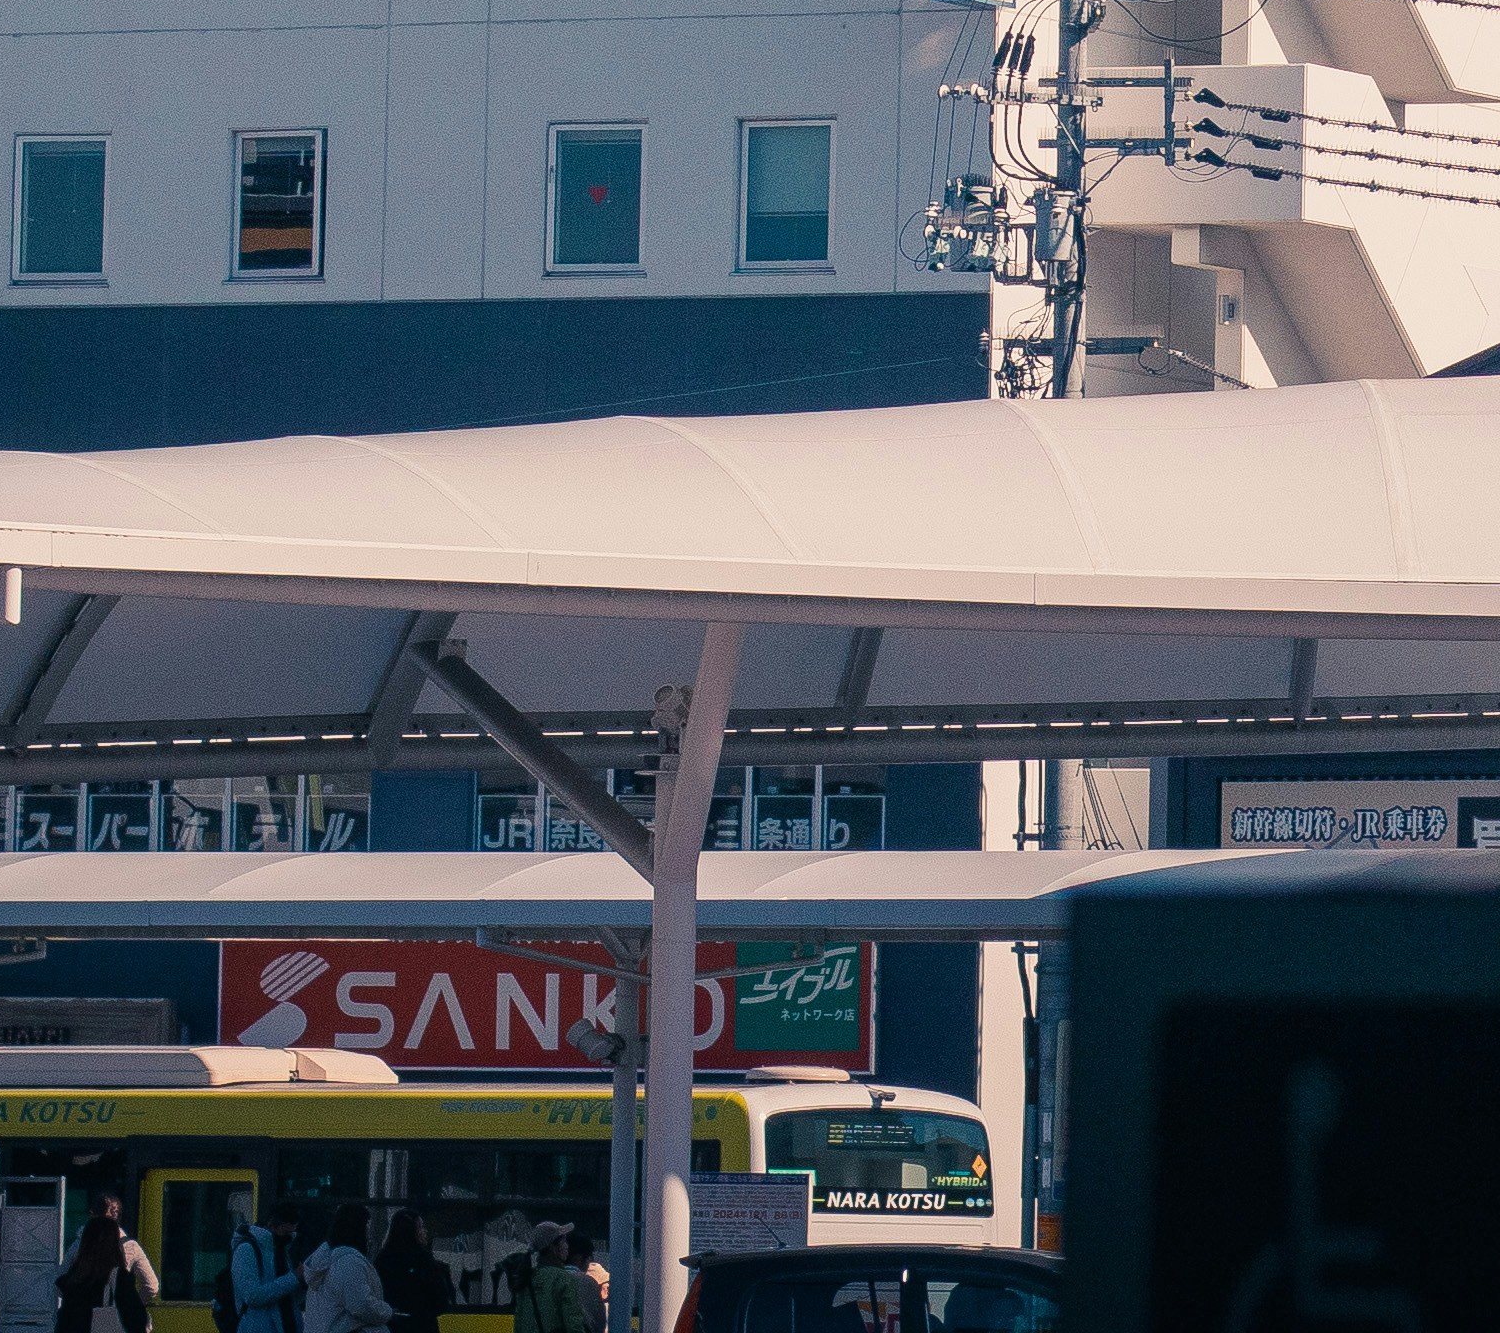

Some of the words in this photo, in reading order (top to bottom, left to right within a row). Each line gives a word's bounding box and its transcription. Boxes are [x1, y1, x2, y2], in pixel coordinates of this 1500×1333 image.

[781, 1009, 855, 1023] ネットワーク店
[19, 1101, 117, 1123] KOTSU
[827, 1192, 881, 1208] NARA
[886, 1193, 946, 1210] KOTSU
